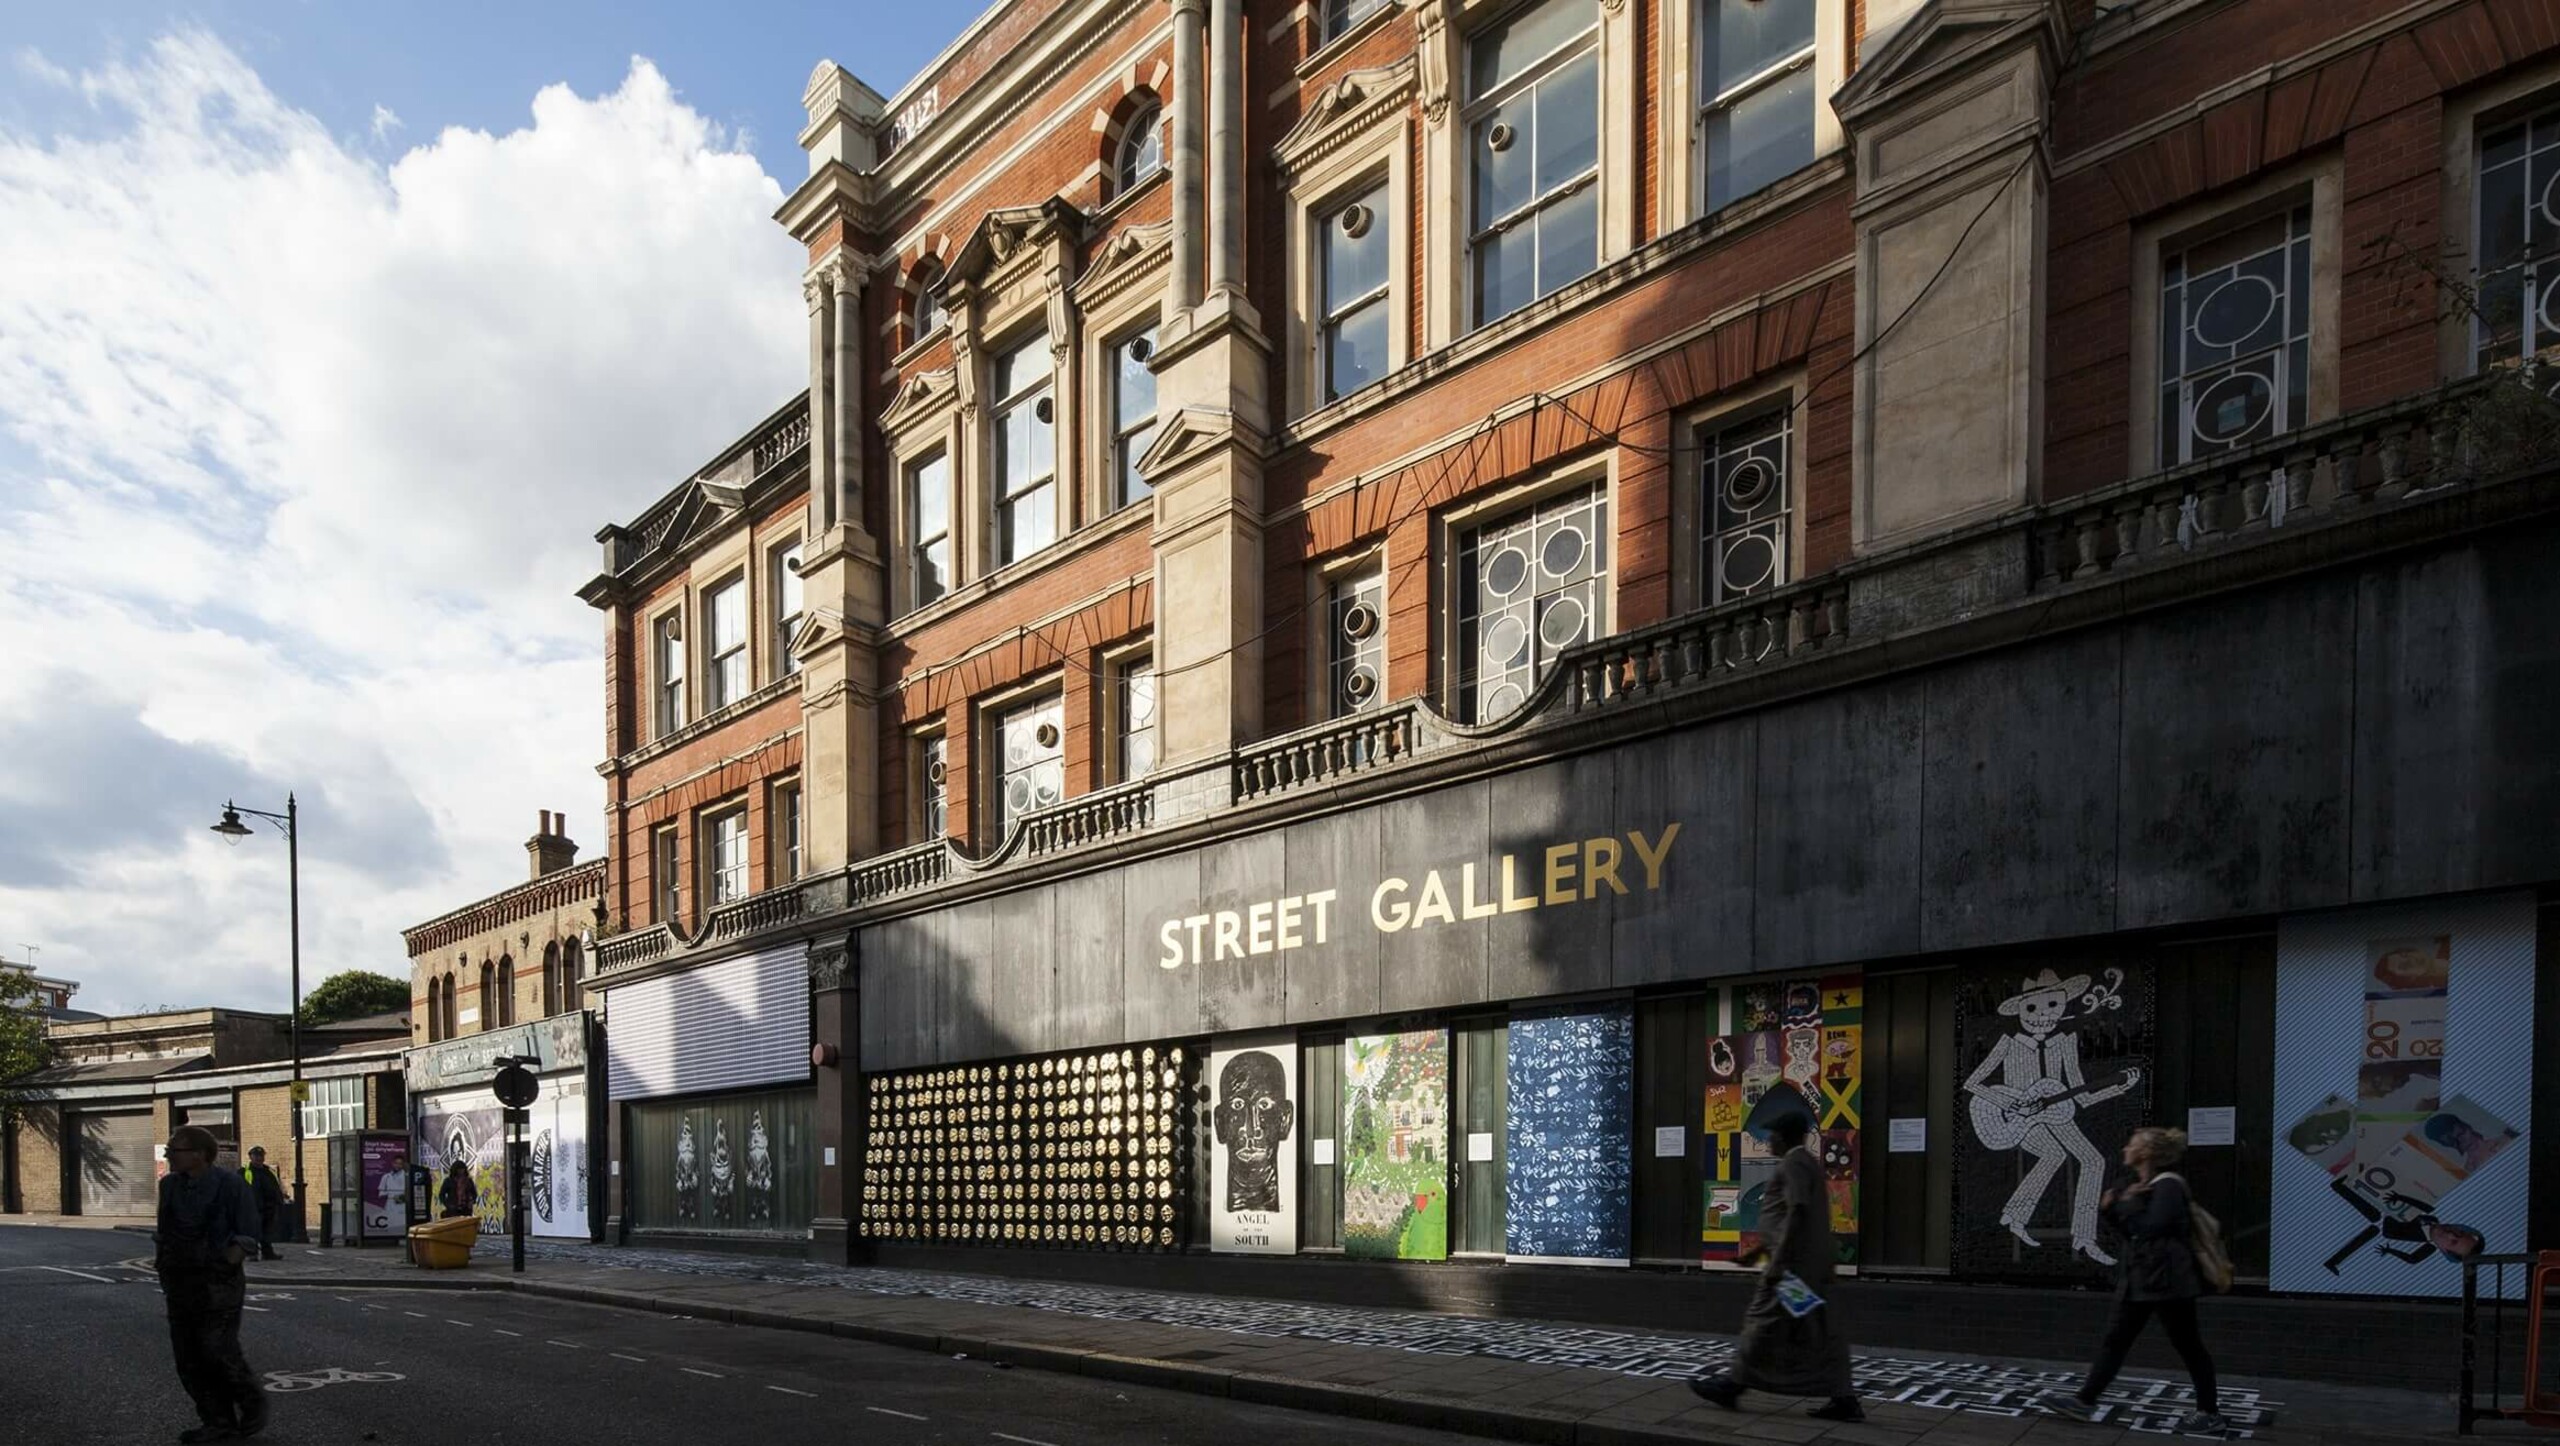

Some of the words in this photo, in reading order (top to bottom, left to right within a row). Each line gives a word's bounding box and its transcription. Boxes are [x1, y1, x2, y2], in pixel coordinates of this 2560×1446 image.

[1159, 888, 1337, 969] STREET
[1370, 822, 1682, 933] GALLERY
[2366, 1020, 2400, 1059] 20
[414, 1171, 422, 1183] P
[2353, 1166, 2396, 1198] 10
[1236, 1213, 1270, 1225] ANGEL
[1234, 1235, 1269, 1246] SOUTH
